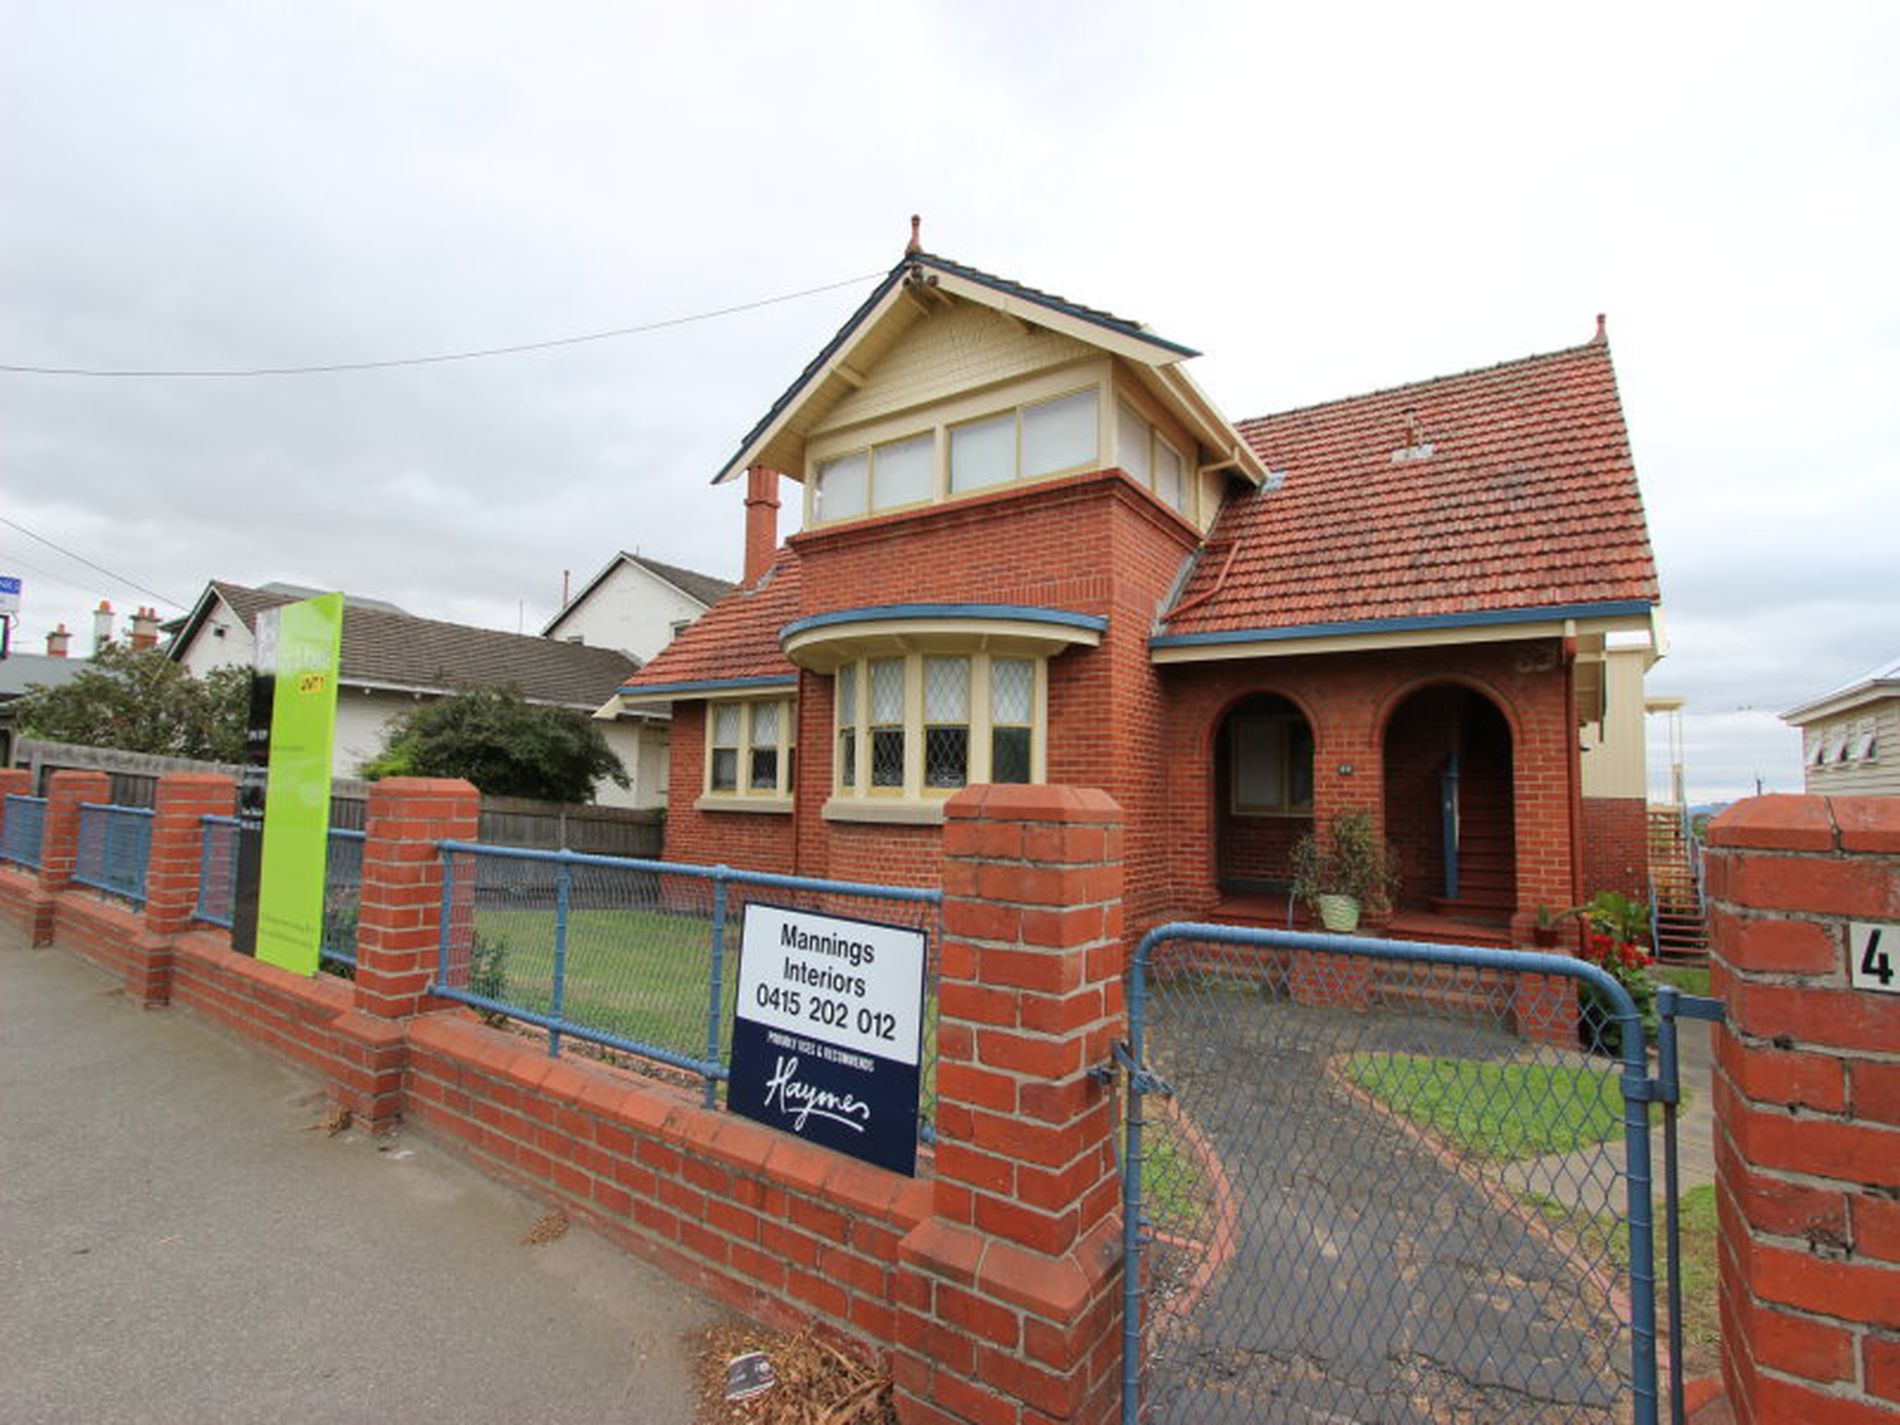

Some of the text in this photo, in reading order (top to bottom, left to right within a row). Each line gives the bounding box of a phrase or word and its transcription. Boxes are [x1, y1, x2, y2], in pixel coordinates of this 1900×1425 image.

[780, 923, 875, 967] Mannings
[1861, 928, 1894, 985] 4
[783, 957, 866, 998] Interiors
[756, 982, 896, 1041] 0415 202 012
[764, 1056, 870, 1132] Haymes
